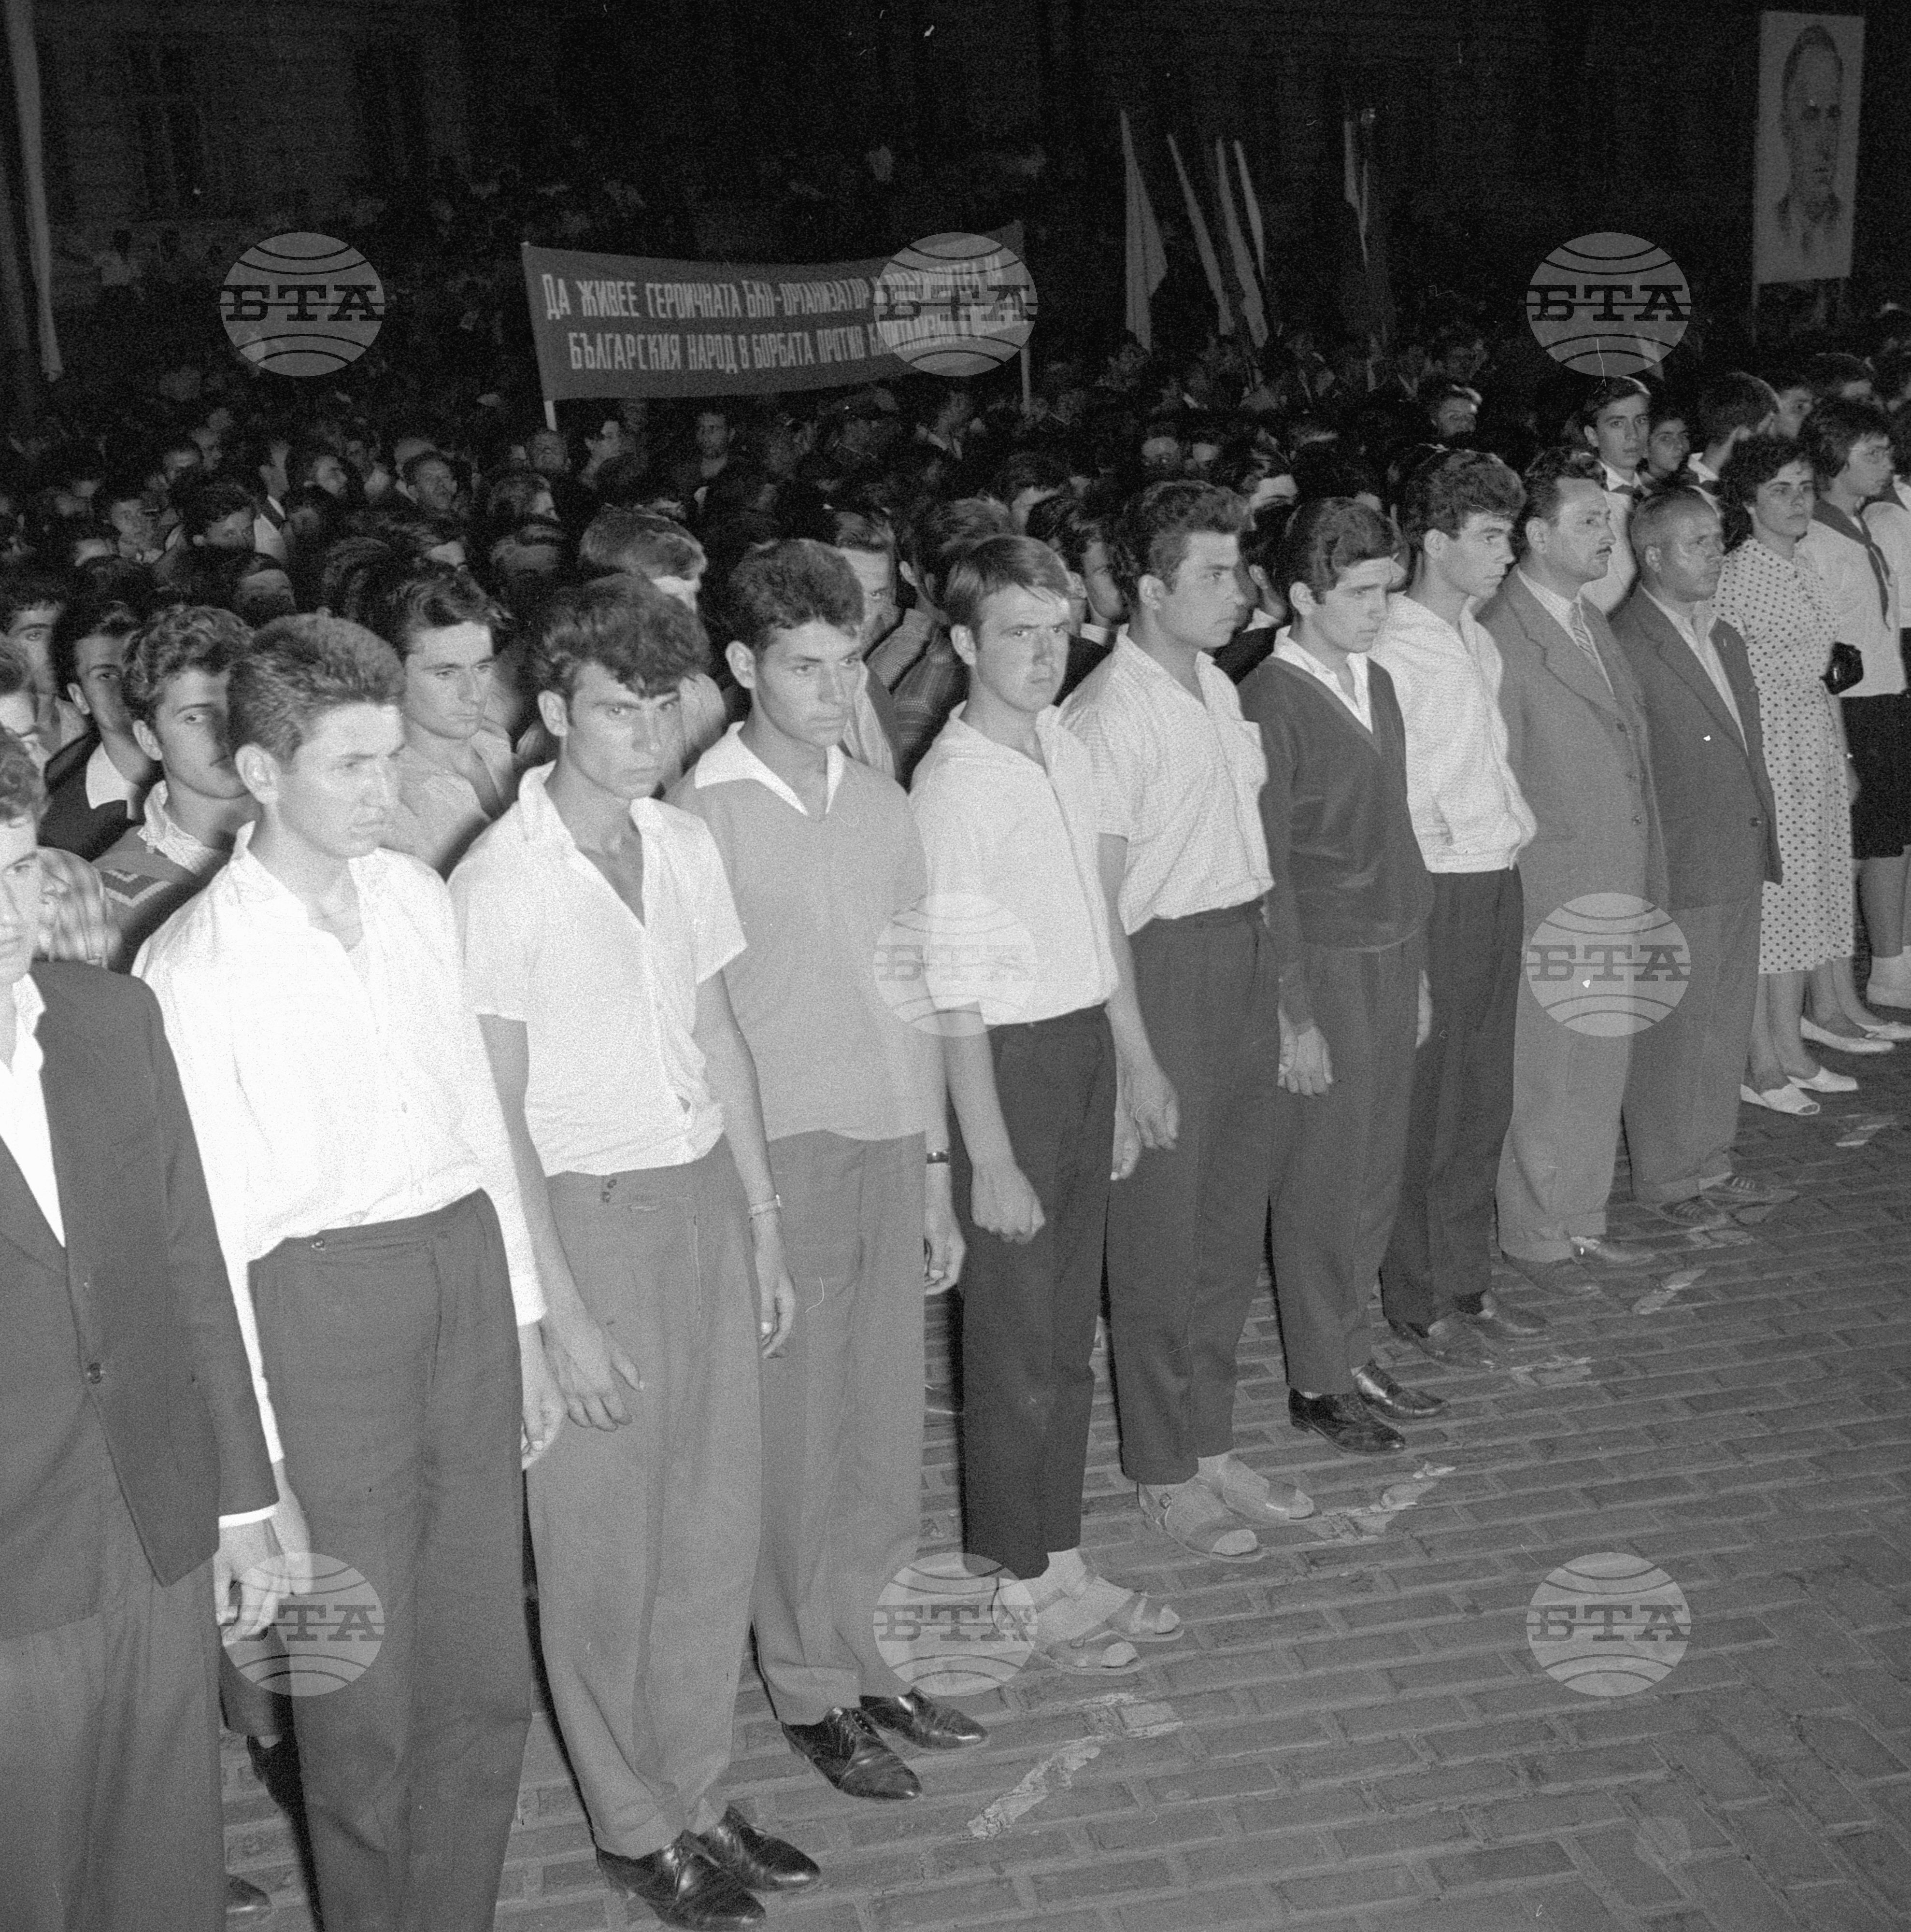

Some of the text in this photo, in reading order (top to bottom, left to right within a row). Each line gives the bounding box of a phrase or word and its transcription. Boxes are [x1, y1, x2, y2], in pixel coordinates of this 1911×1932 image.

[542, 273, 571, 320] ДА
[576, 280, 640, 317] ЖИВЕЕ
[645, 282, 742, 318] ГЕРОИЧНАТА
[569, 332, 681, 370] БЪЛГАРСКИЯ
[686, 334, 738, 374] НАРОД
[738, 334, 750, 369] В
[751, 332, 815, 368] БОРБАТА
[816, 326, 866, 363] ПРОТИВ
